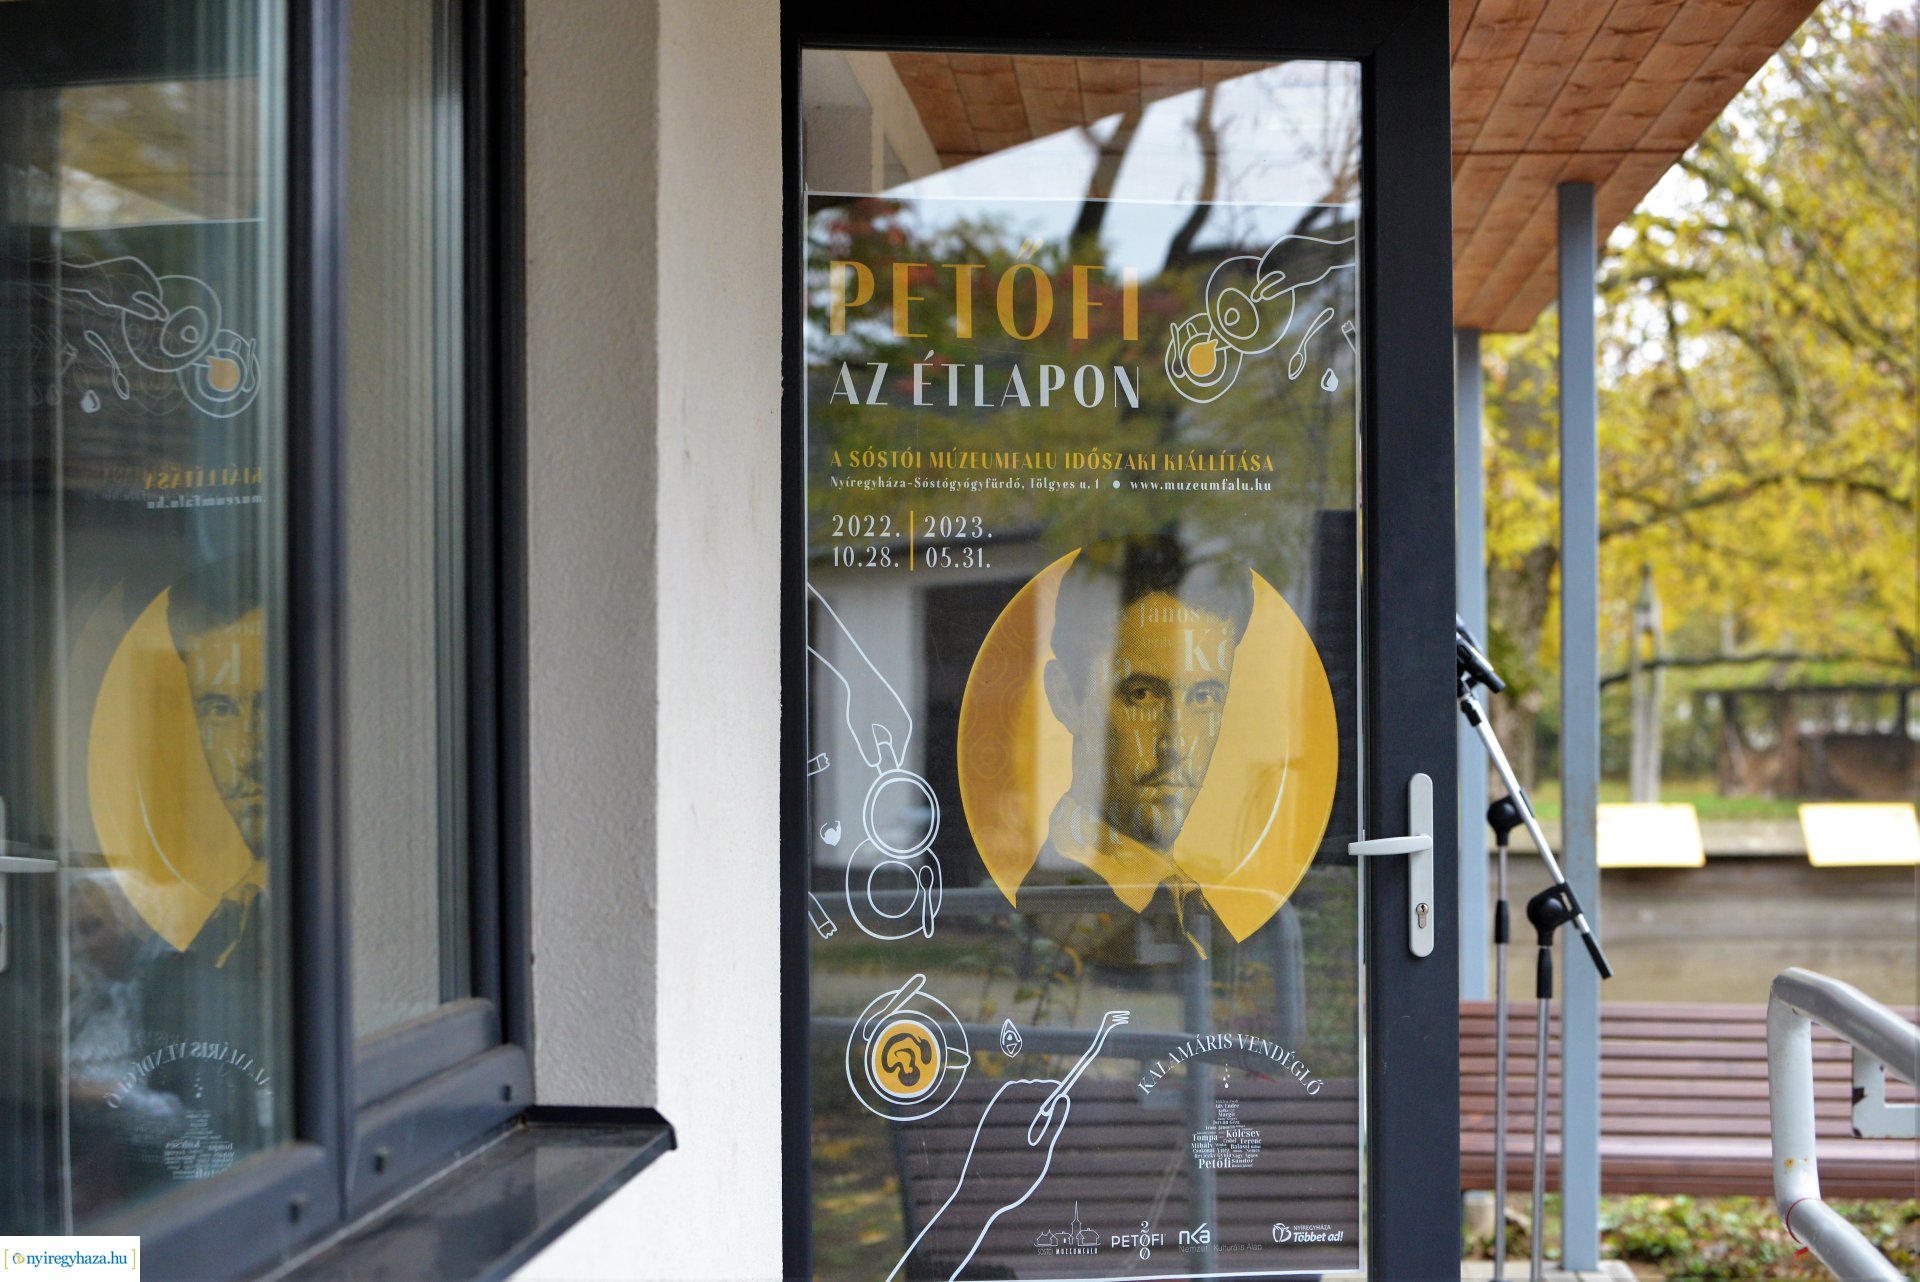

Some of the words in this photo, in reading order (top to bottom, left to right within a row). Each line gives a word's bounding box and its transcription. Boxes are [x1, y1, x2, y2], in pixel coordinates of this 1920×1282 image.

[829, 238, 1139, 341] PETŐFI
[829, 361, 889, 405] AZ
[913, 349, 1140, 408] ÉTLAPON
[830, 450, 842, 467] A
[849, 445, 921, 469] SÓSTÓI
[929, 447, 1058, 470] MÚZEUMFALU
[1065, 447, 1156, 471] IDŐSZAKI
[1164, 449, 1274, 472] KIÁLLÍTÁSA
[1030, 477, 1076, 492] Tölgyes
[1130, 477, 1272, 491] www.muzeumfalu.hu
[831, 514, 900, 538] 2022.
[923, 515, 993, 539] 2023.
[832, 545, 899, 568] 10.28.
[925, 546, 991, 569] 05.31.
[1138, 1033, 1233, 1096] KALAMÁRIS
[1237, 1033, 1324, 1096] VENDÉGLŐ
[1192, 1134, 1218, 1143] Tompa
[1226, 1128, 1261, 1138] Kölcsey
[1198, 1157, 1232, 1169] Petőfi
[1293, 1231, 1326, 1242] Többet
[1328, 1231, 1344, 1242] ad!
